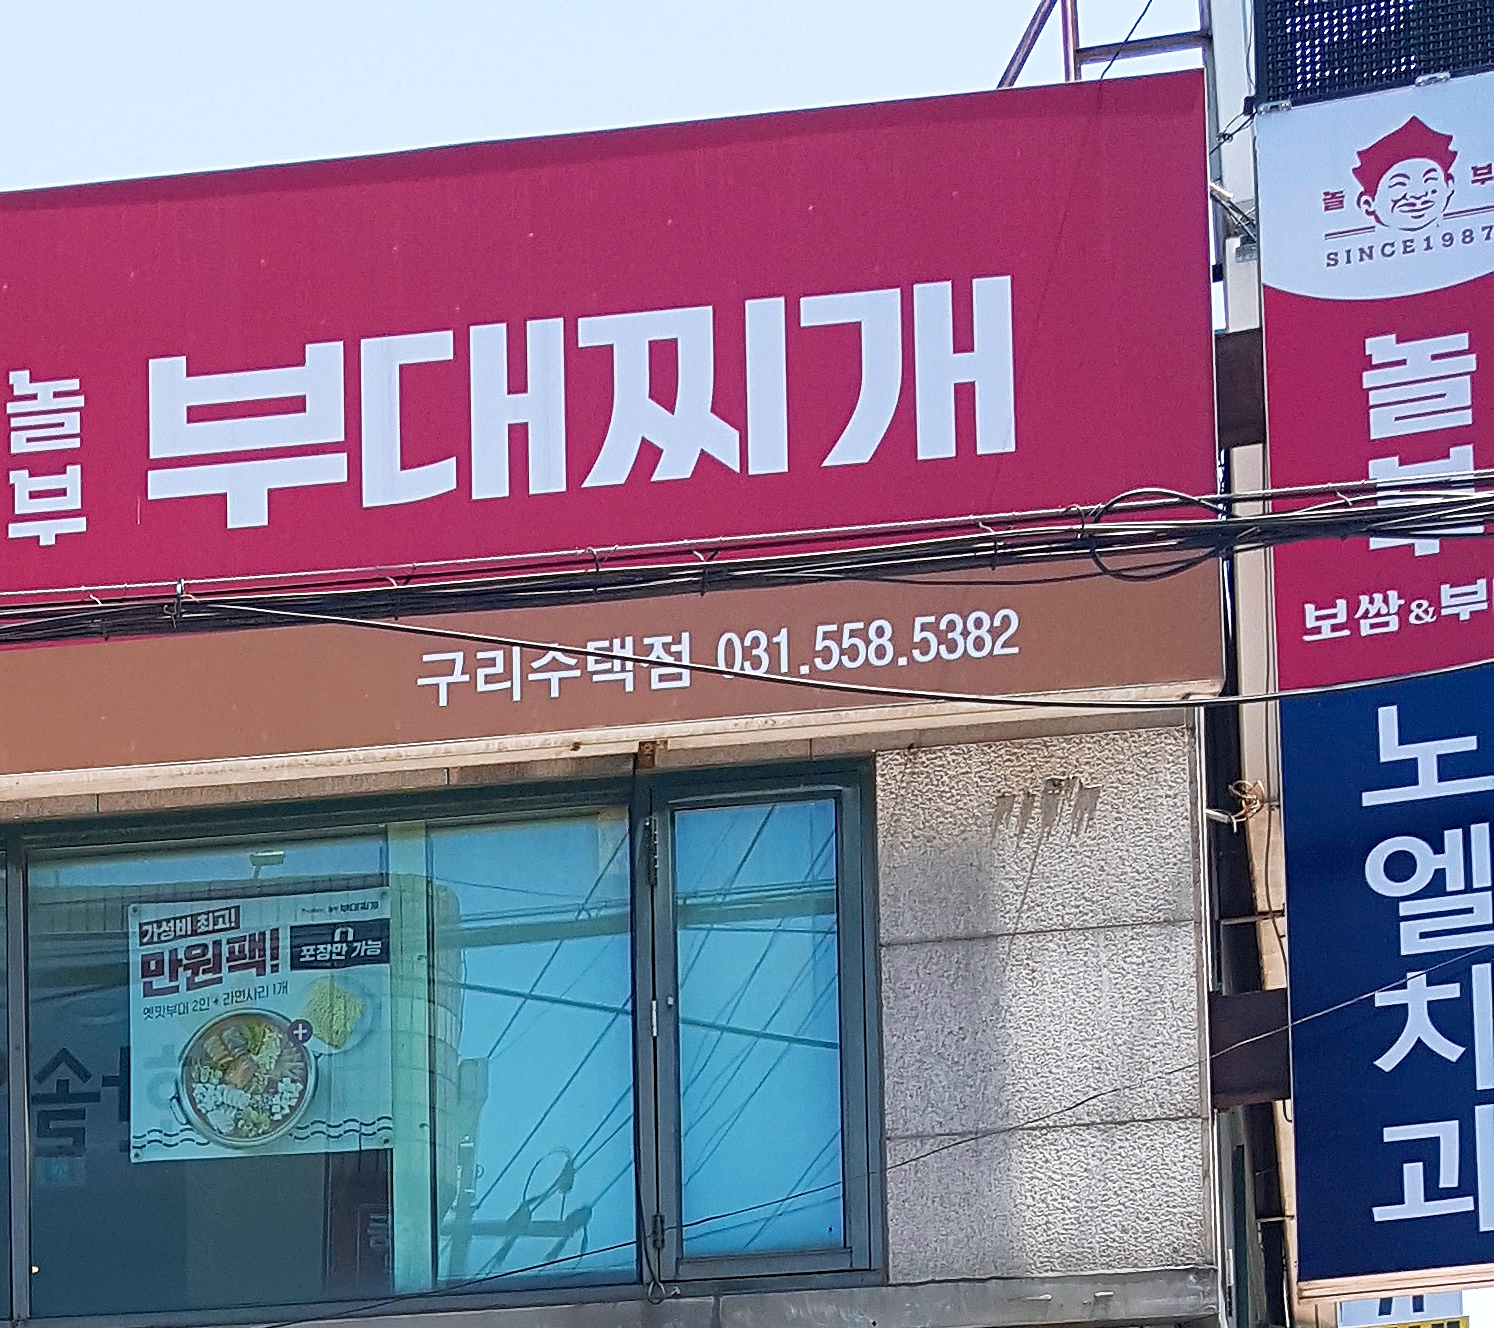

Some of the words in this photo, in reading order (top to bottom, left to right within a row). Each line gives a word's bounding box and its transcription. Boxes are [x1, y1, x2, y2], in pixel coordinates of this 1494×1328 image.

[148, 275, 1016, 529] 부대찌개
[6, 368, 87, 546] 놀부
[1303, 580, 1494, 643] 보쌈&부
[417, 631, 693, 707] 구리수택점
[717, 609, 1021, 680] 031.558.5382
[141, 916, 192, 943] 가성비
[196, 908, 236, 934] 최고!
[299, 942, 348, 962] 포장만
[351, 938, 383, 958] 가능
[140, 927, 280, 998] 만원팩!
